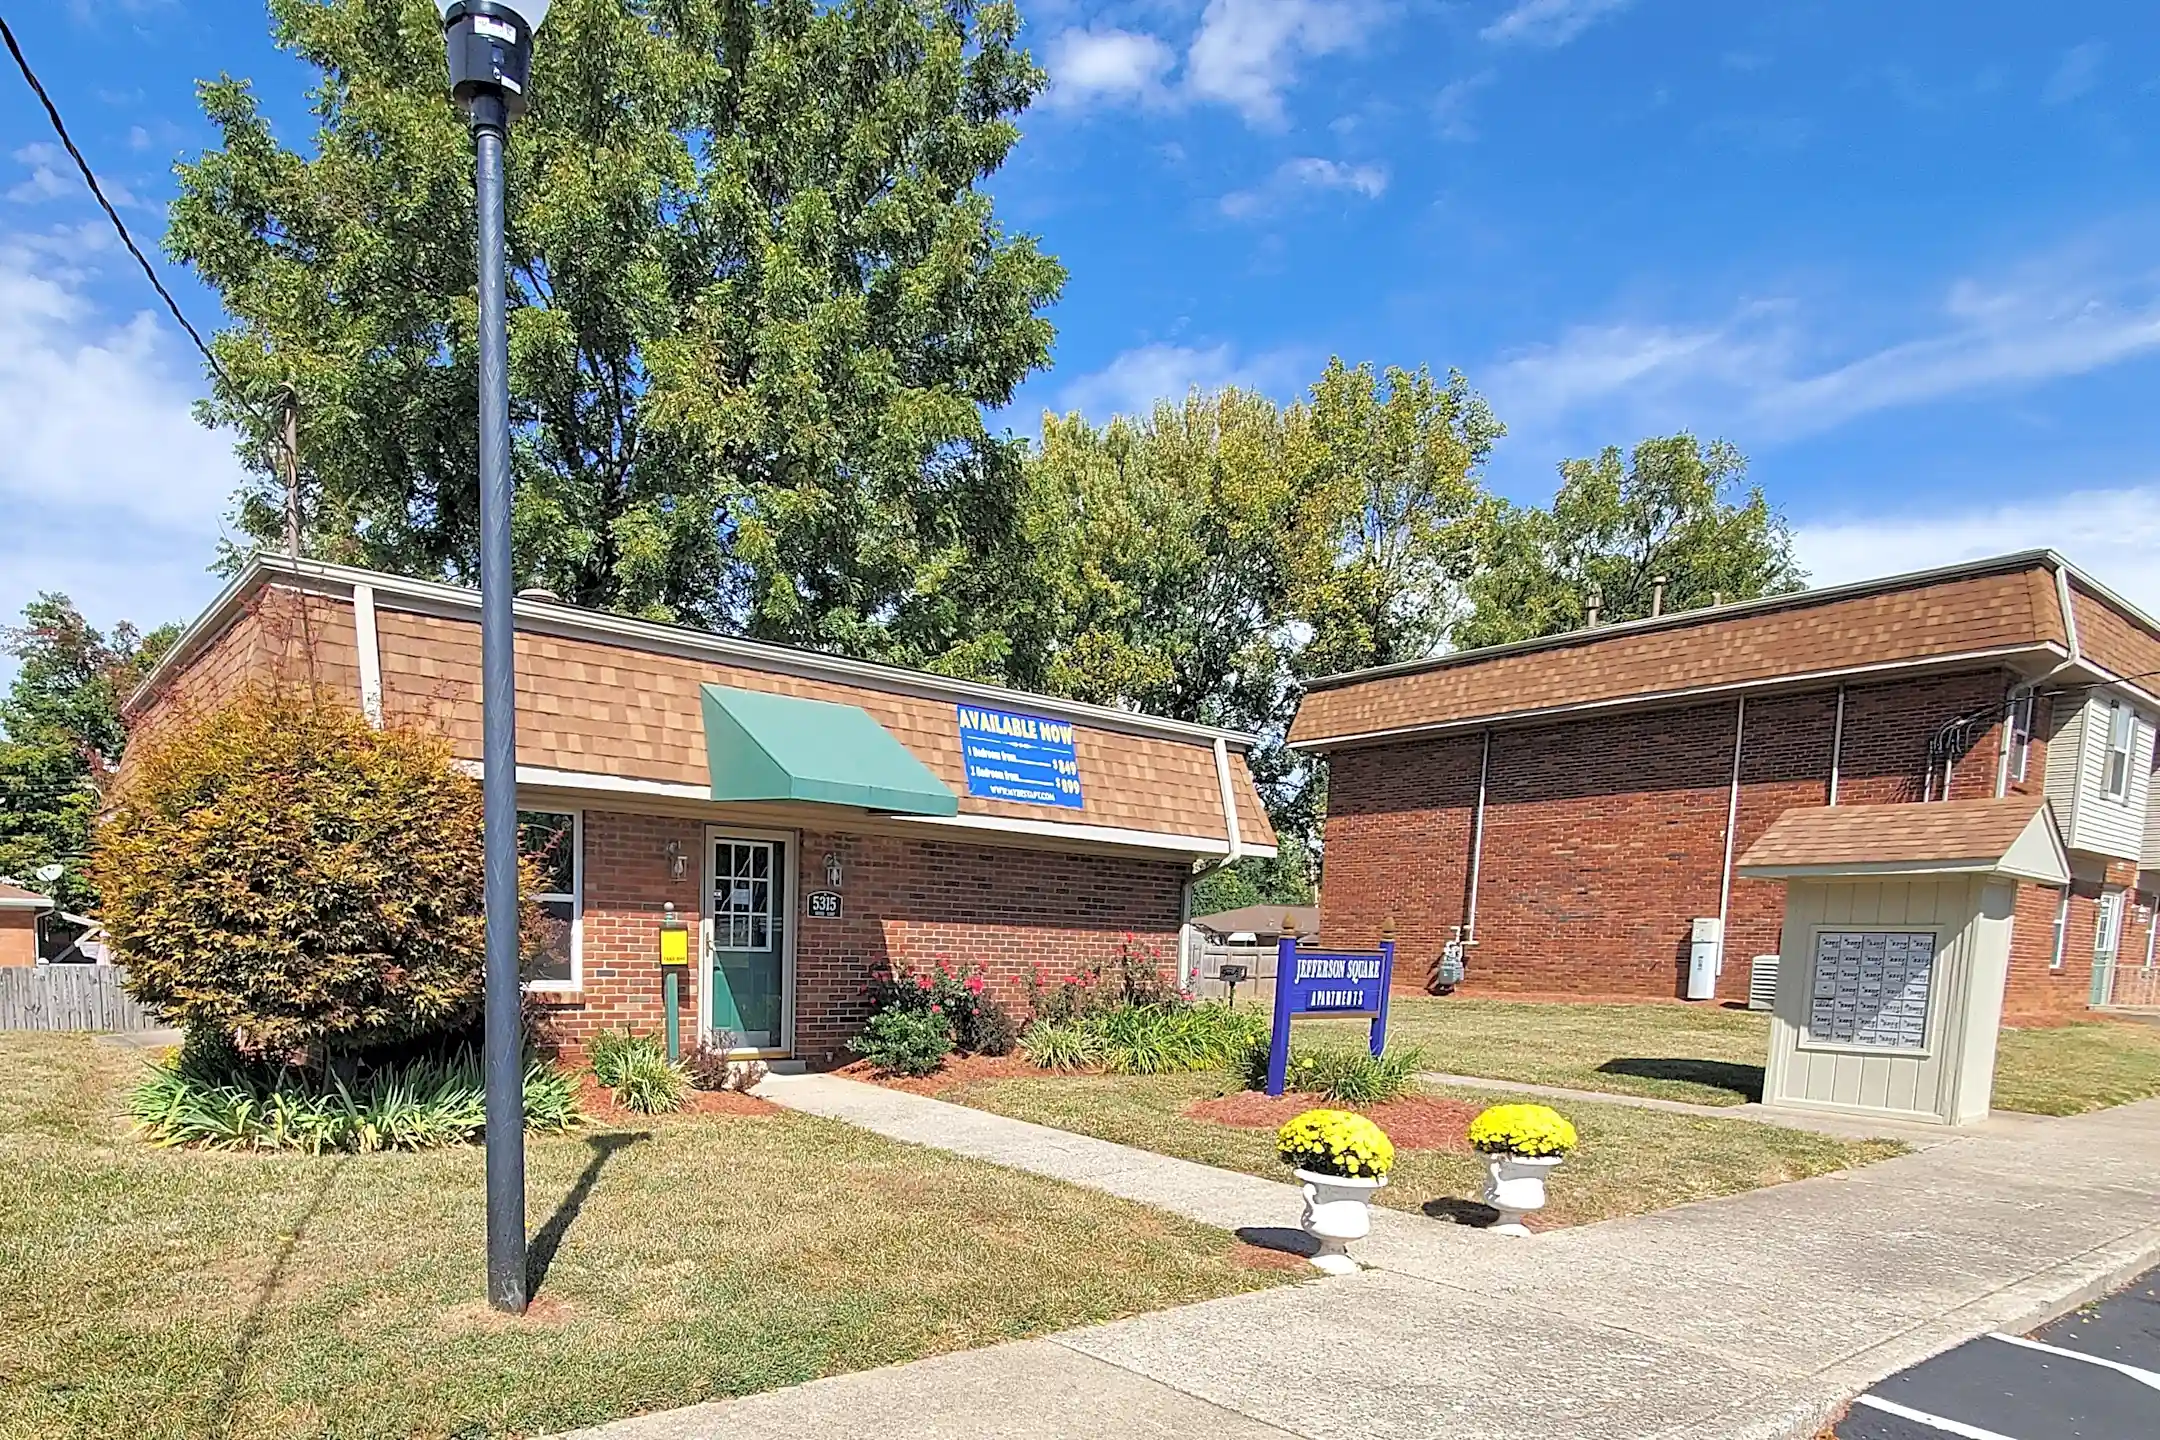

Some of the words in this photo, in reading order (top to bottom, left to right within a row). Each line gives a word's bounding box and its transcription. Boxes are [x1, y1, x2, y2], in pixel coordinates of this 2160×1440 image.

[959, 708, 1038, 739] AVAILABLE
[1039, 721, 1073, 745] NOW
[812, 895, 837, 911] 5315
[1294, 959, 1346, 984] JEFFERSON
[1347, 960, 1380, 984] SQUARE
[1310, 990, 1364, 1006] APARTMENTS
